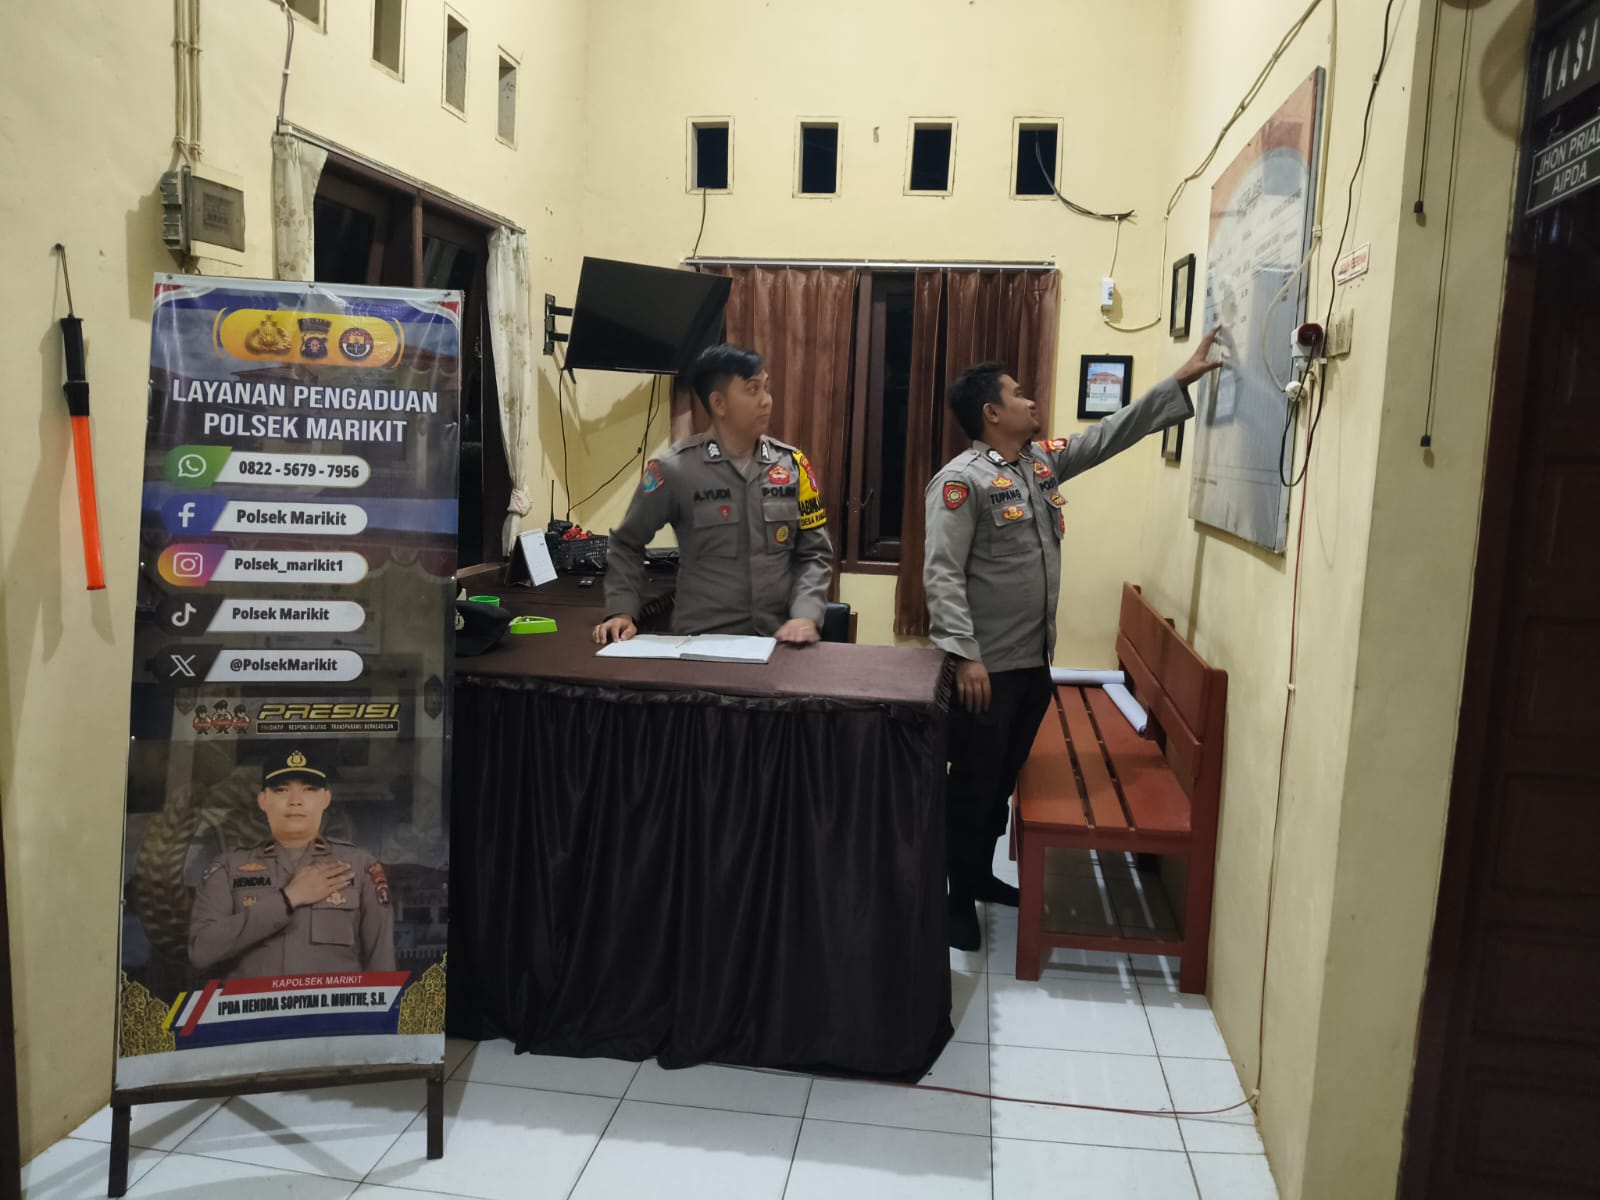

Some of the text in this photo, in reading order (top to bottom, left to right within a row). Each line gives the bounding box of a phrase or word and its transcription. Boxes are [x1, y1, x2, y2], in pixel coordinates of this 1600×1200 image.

[1543, 18, 1599, 99] KASI
[1536, 142, 1567, 177] JHON
[1552, 159, 1587, 195] AIPDA
[173, 379, 438, 413] LAYANAN PENGADUAN
[204, 413, 407, 442] POLSEK MARIKIT
[236, 509, 346, 526] Polsek Marikit
[234, 557, 343, 573] Polsek_marikit1
[232, 607, 329, 620] Polsek Marikit
[230, 658, 338, 672] @PolsekMarikit
[259, 703, 400, 719] PRESISI
[272, 975, 363, 988] KAPOLSEK MARIKIT
[218, 991, 387, 1016] IPDA HENDRA SOPIYAN D. MUNTHE, S.H.
